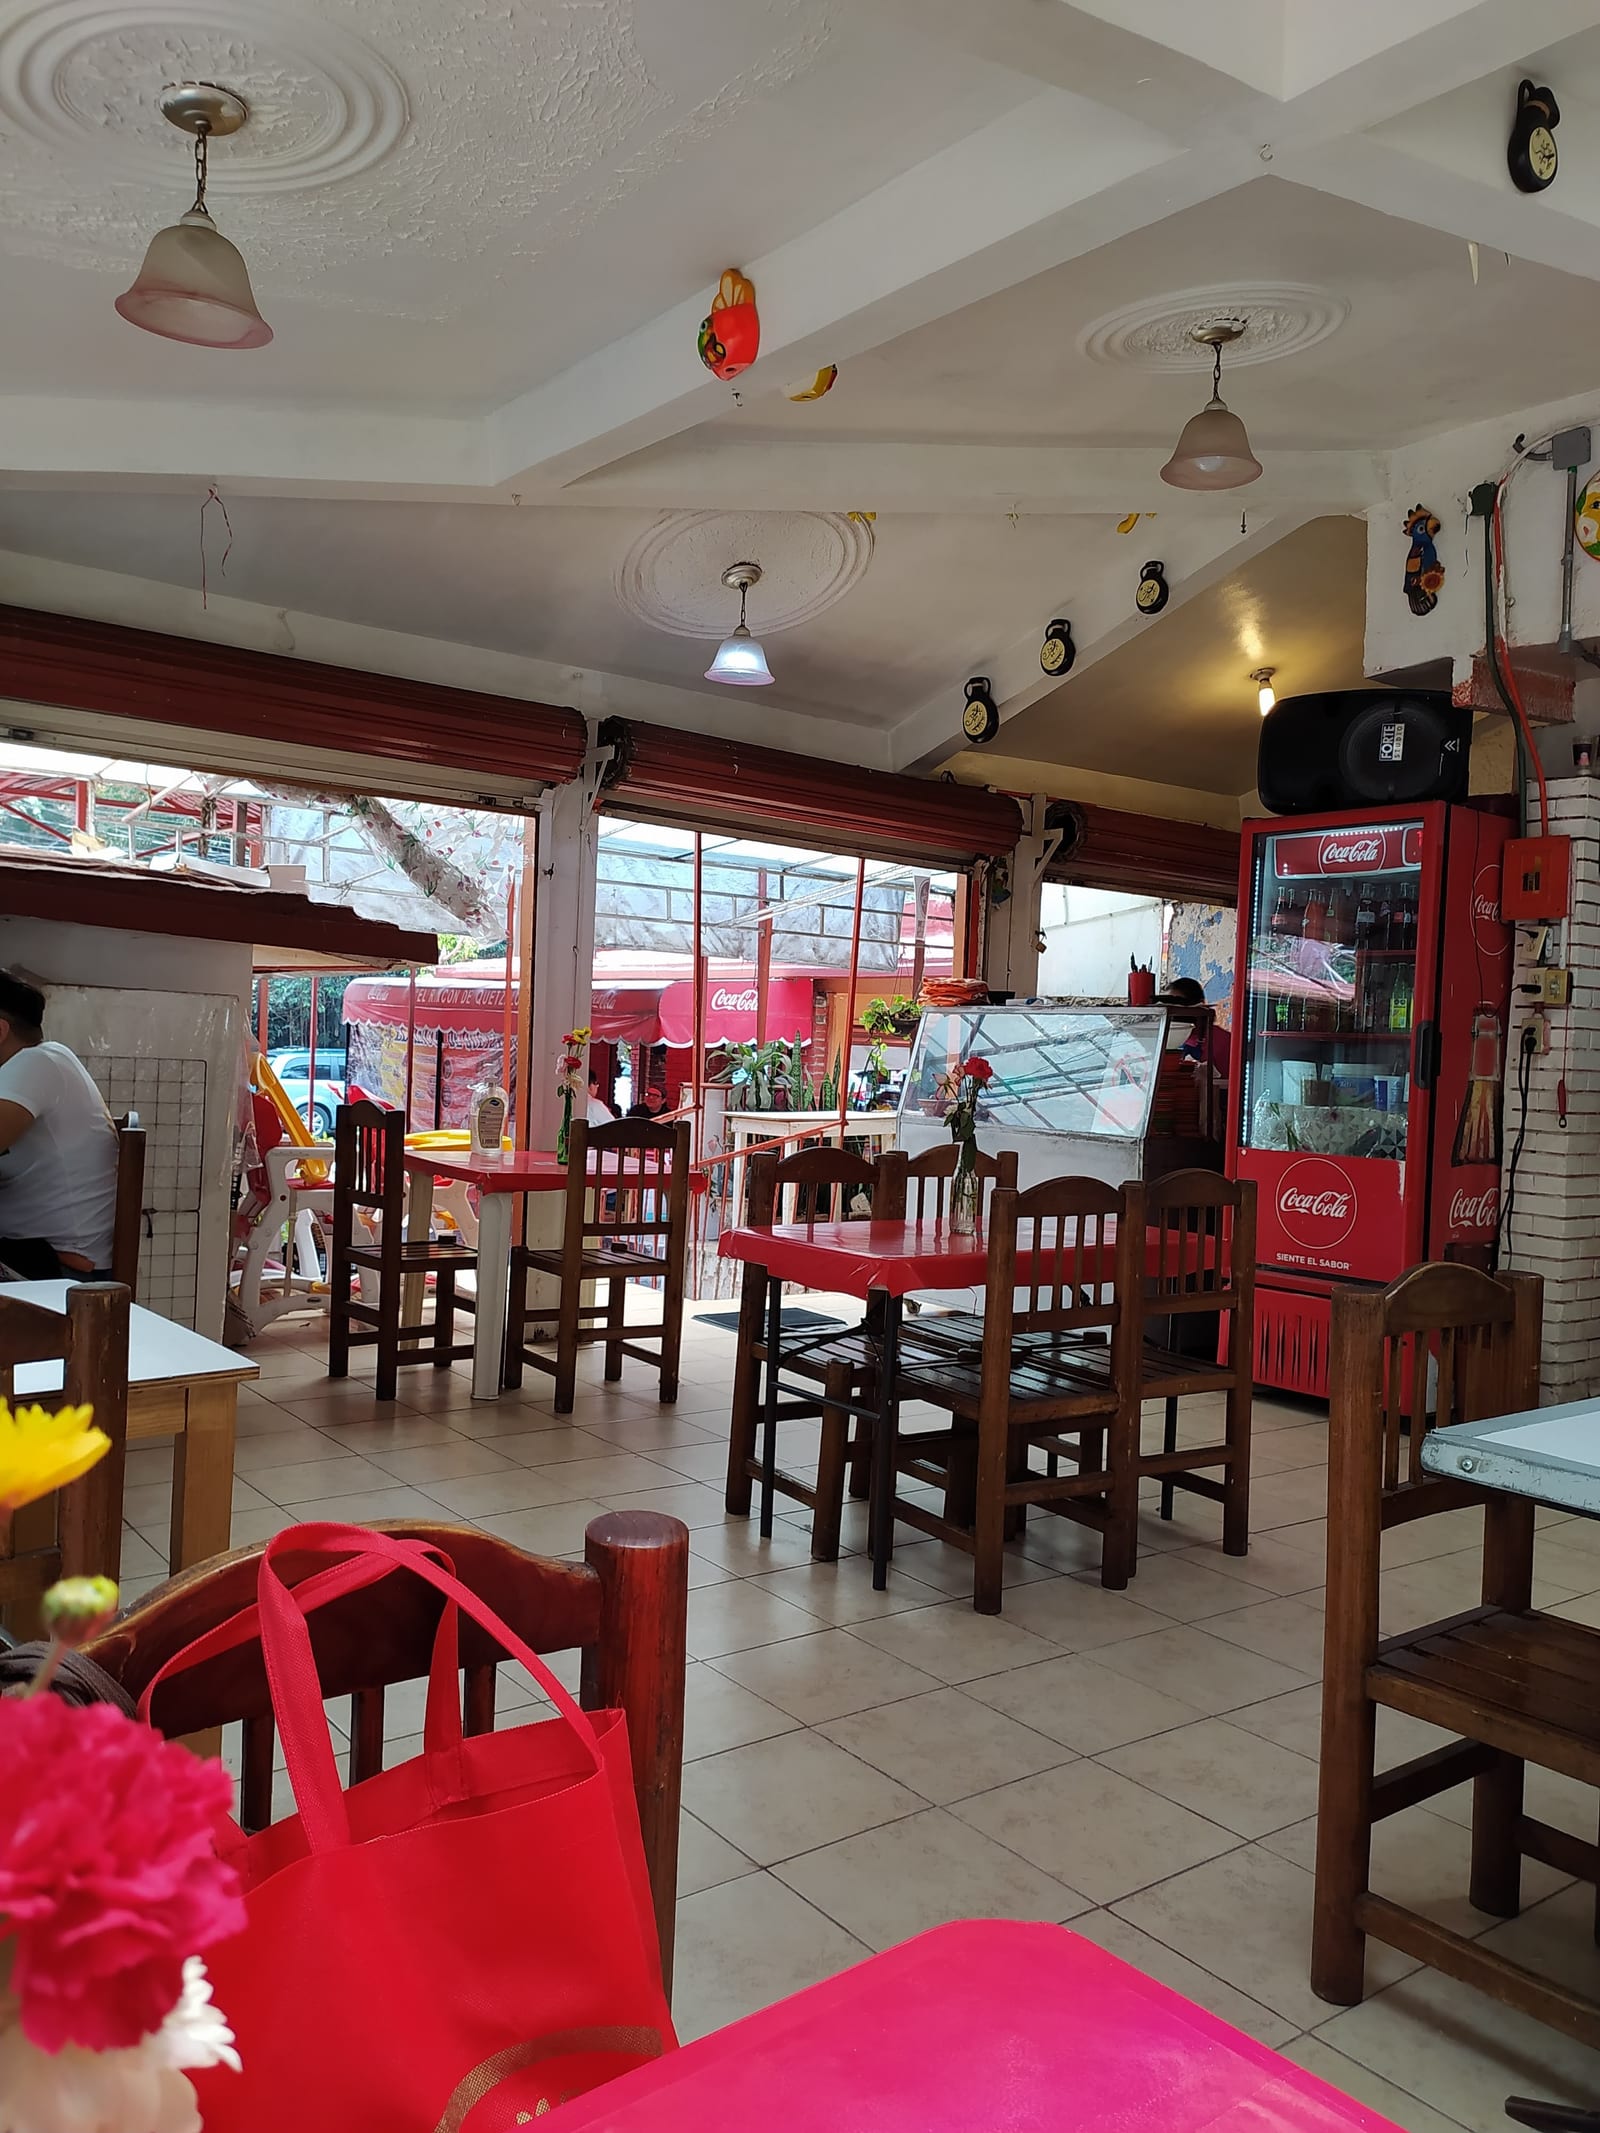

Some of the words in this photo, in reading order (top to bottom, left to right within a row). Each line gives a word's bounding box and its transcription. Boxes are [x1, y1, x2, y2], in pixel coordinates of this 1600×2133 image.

[1381, 725, 1395, 759] FORTE
[1393, 725, 1403, 759] STUDIO
[1322, 839, 1382, 864] Coca-Cola
[1280, 1187, 1352, 1218] Coca-Cola
[1276, 1253, 1306, 1264] SIENTE
[1307, 1257, 1318, 1266] EL
[1319, 1258, 1350, 1270] SABOR
